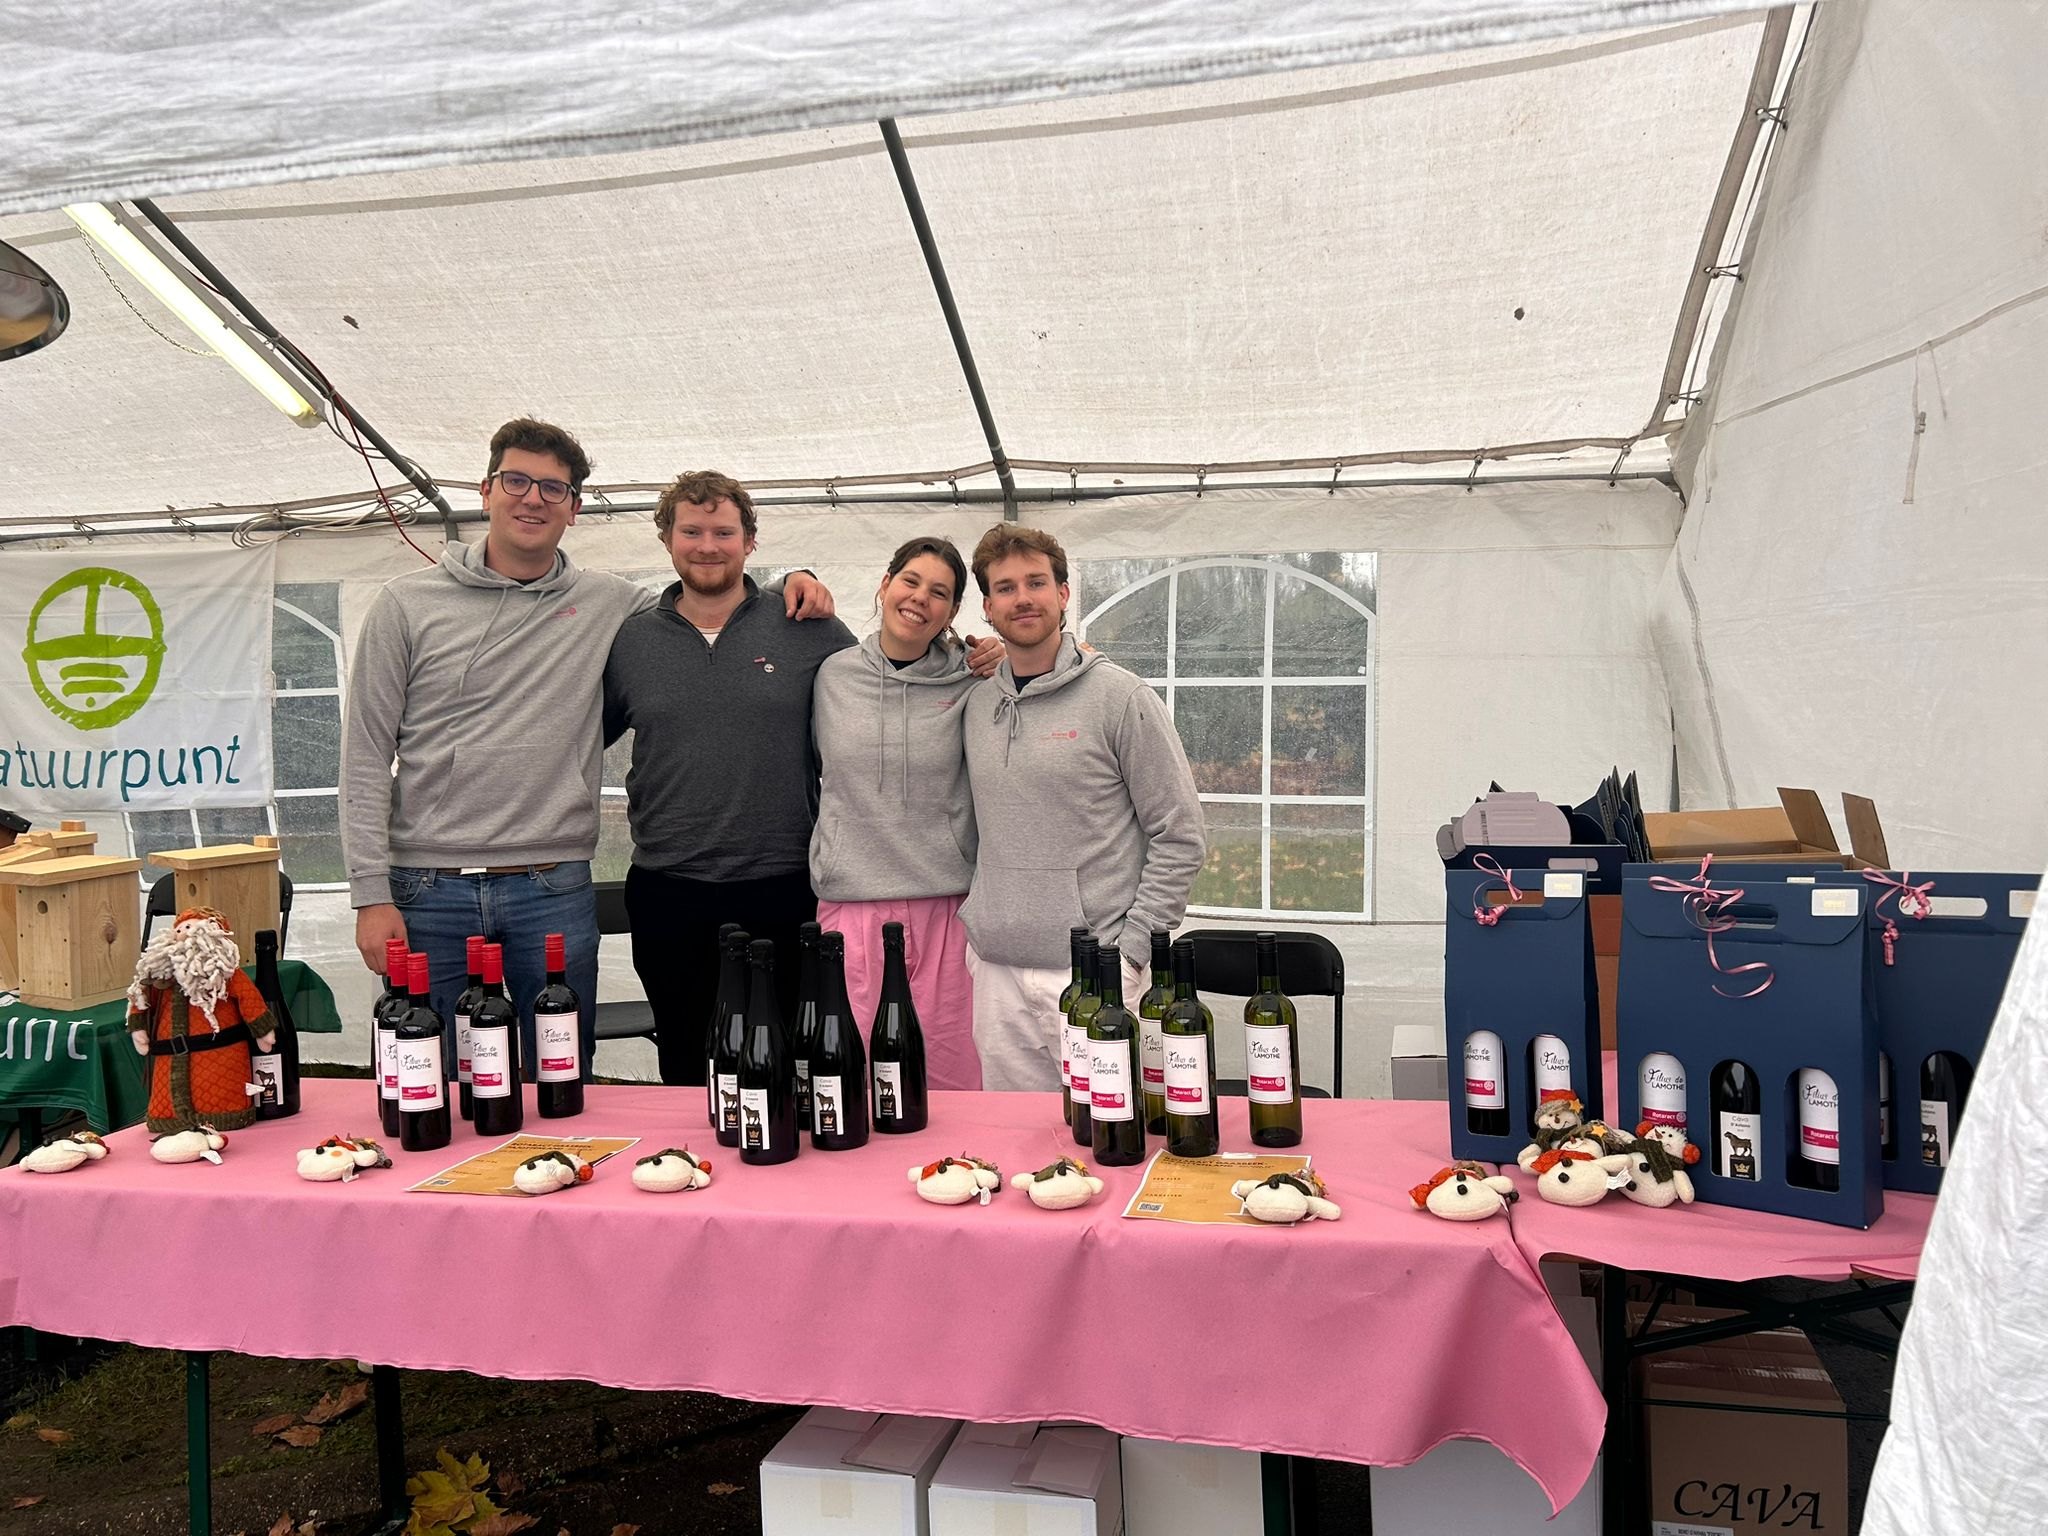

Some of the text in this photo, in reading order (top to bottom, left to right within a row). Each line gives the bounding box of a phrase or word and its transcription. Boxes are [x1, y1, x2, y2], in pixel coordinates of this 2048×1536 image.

[1547, 1064, 1569, 1072] LAMOT
[1651, 1082, 1686, 1091] LAMOTHE
[1652, 1111, 1676, 1120] Rotaract
[1810, 1130, 1834, 1140] Rotaract
[1673, 1480, 1826, 1530] CAVA
